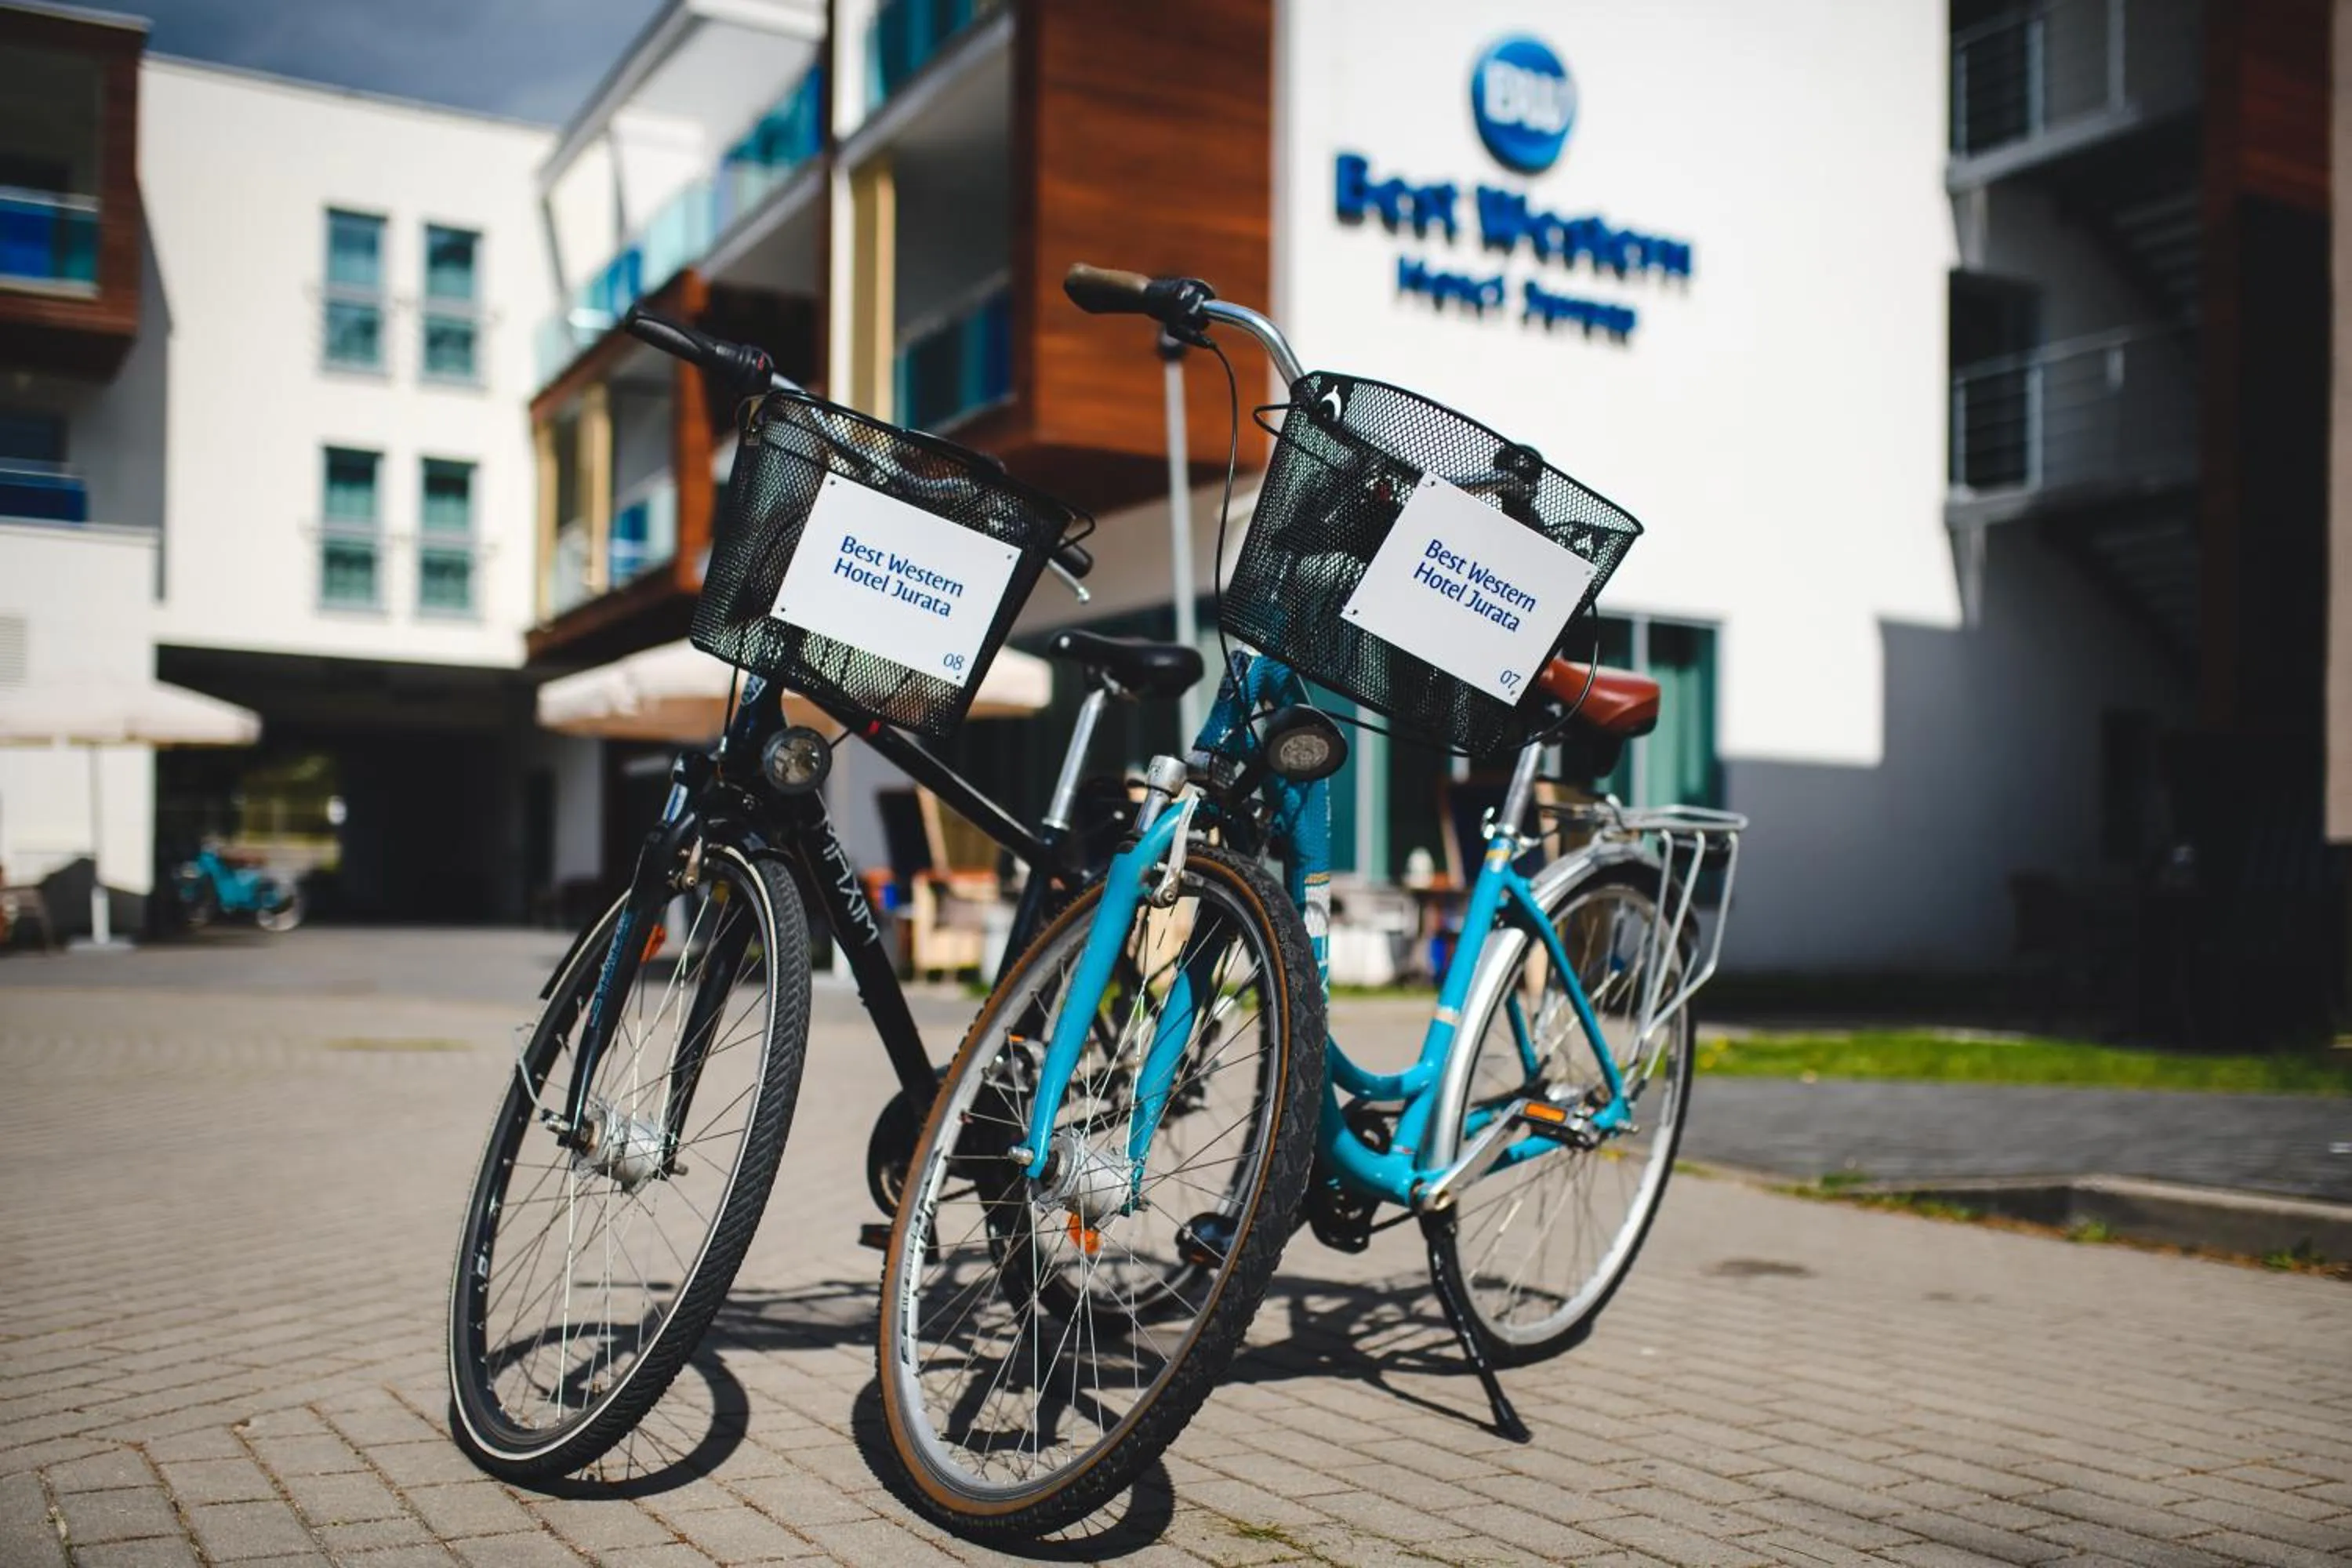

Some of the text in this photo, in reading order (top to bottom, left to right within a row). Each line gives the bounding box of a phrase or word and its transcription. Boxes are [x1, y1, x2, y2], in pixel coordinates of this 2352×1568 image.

[833, 557, 951, 617] Hotel Jurata
[841, 535, 964, 597] Best Western
[1425, 539, 1536, 612] Best Western
[1414, 562, 1520, 632] Hotel Jurata
[943, 653, 964, 671] 08
[1500, 670, 1521, 689] 07
